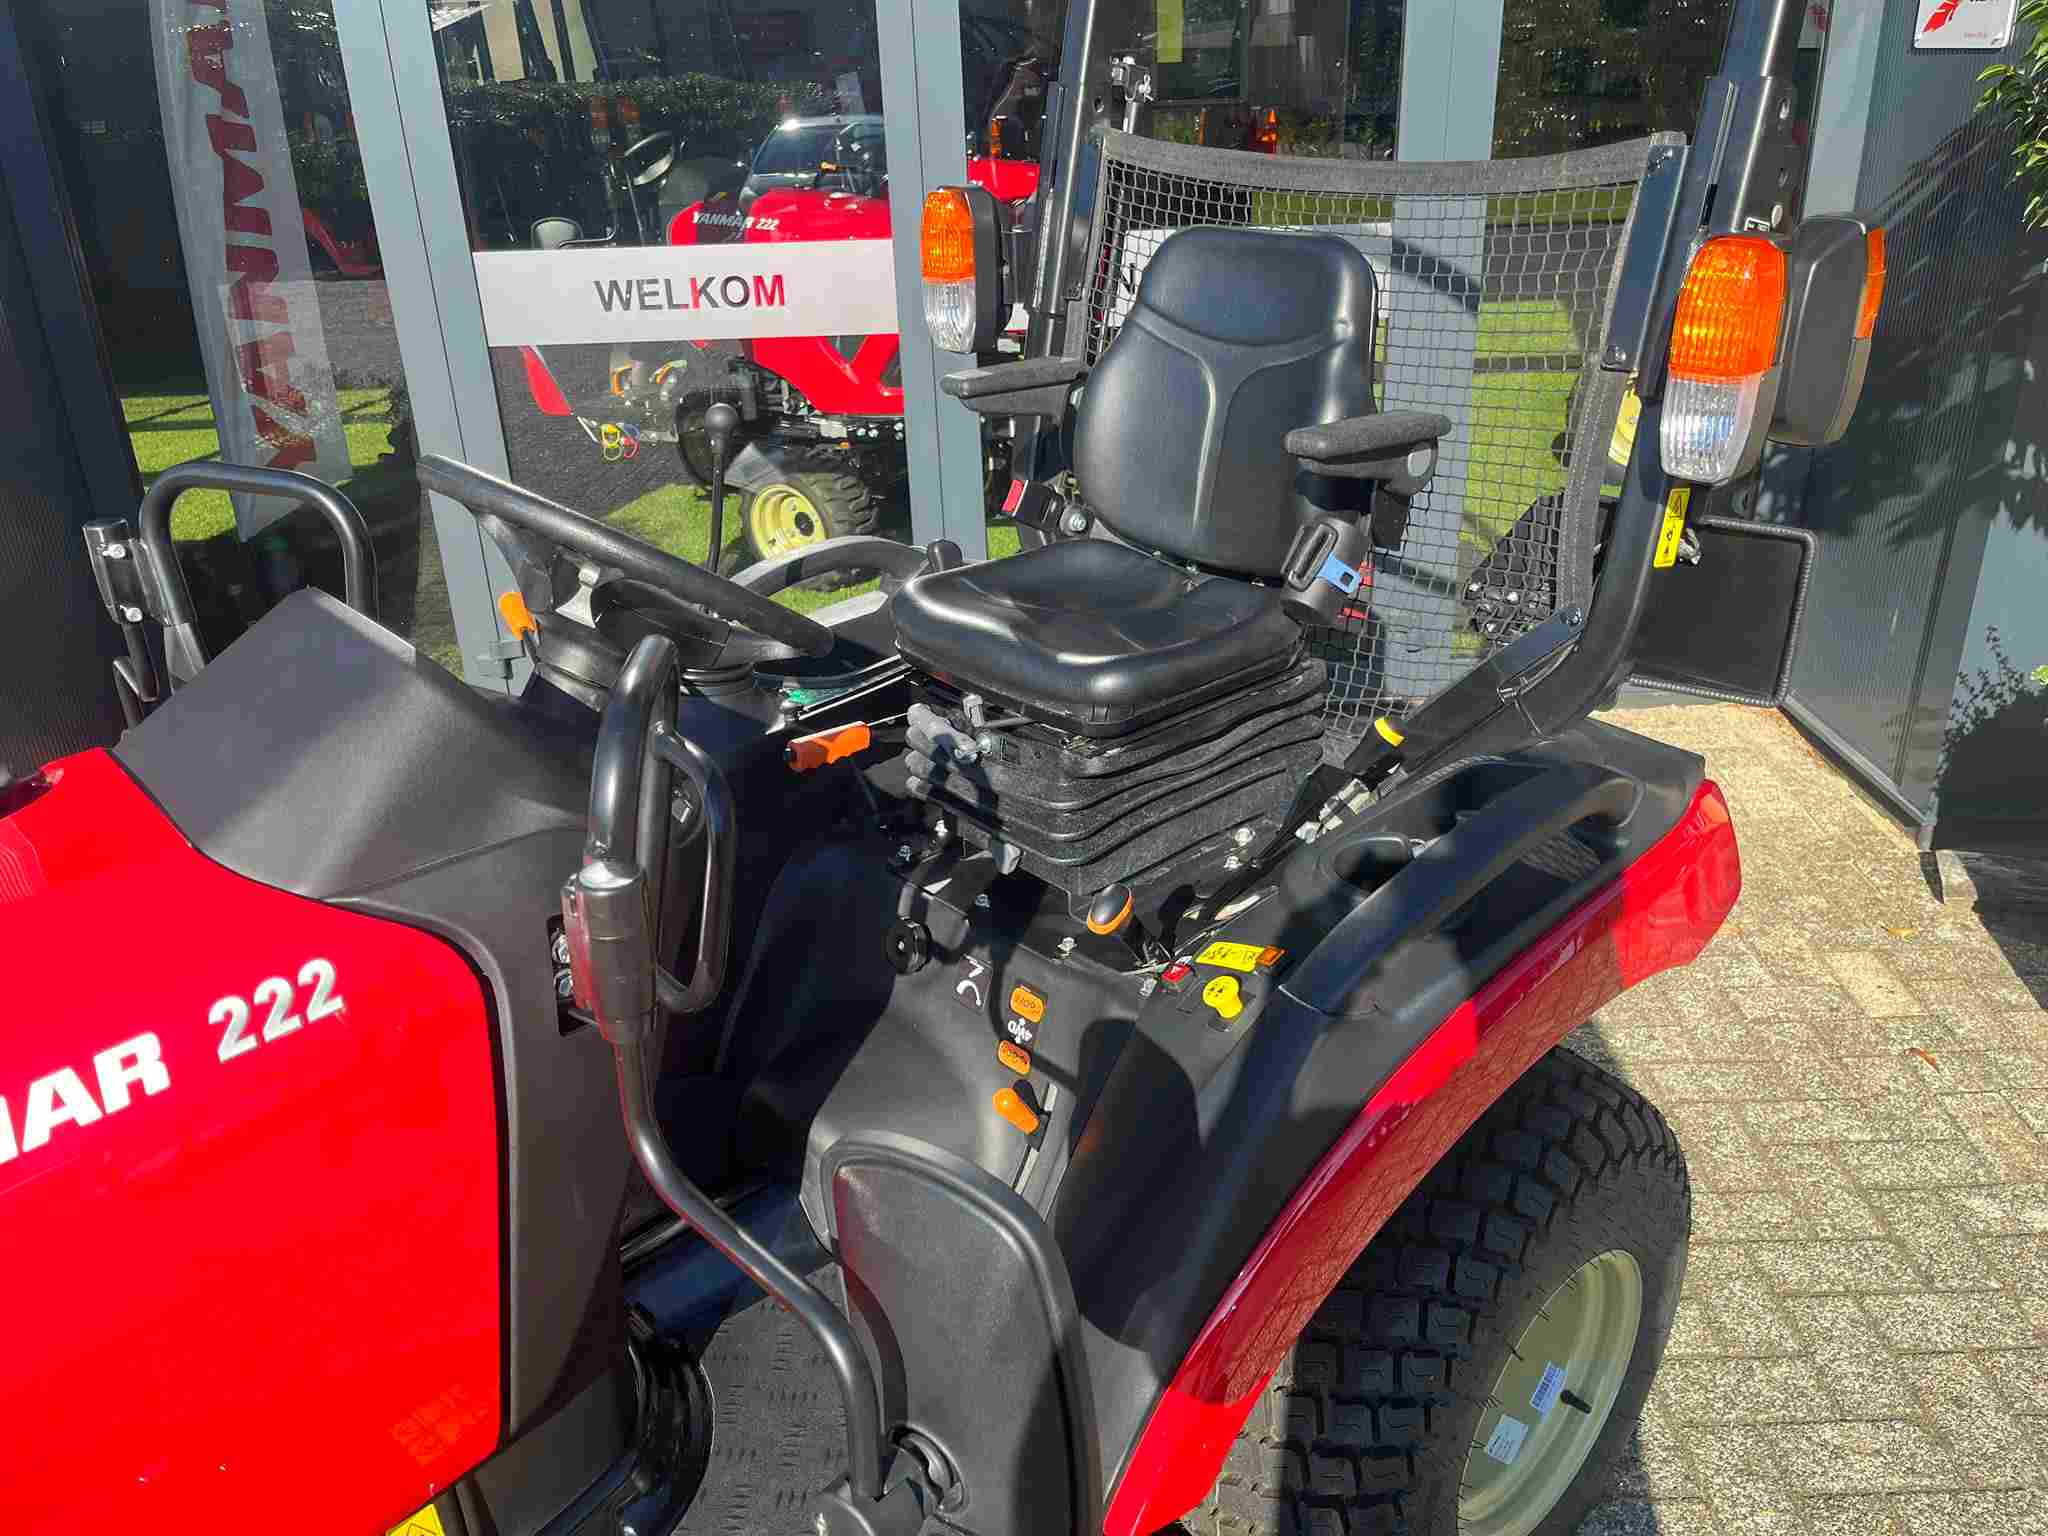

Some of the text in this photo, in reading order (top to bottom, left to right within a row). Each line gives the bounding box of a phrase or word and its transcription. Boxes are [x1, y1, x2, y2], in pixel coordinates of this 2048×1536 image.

[187, 0, 319, 472] YANMA
[692, 211, 780, 231] YANMAR 222
[593, 274, 785, 313] WELKOM
[0, 957, 345, 1165] AR 222
